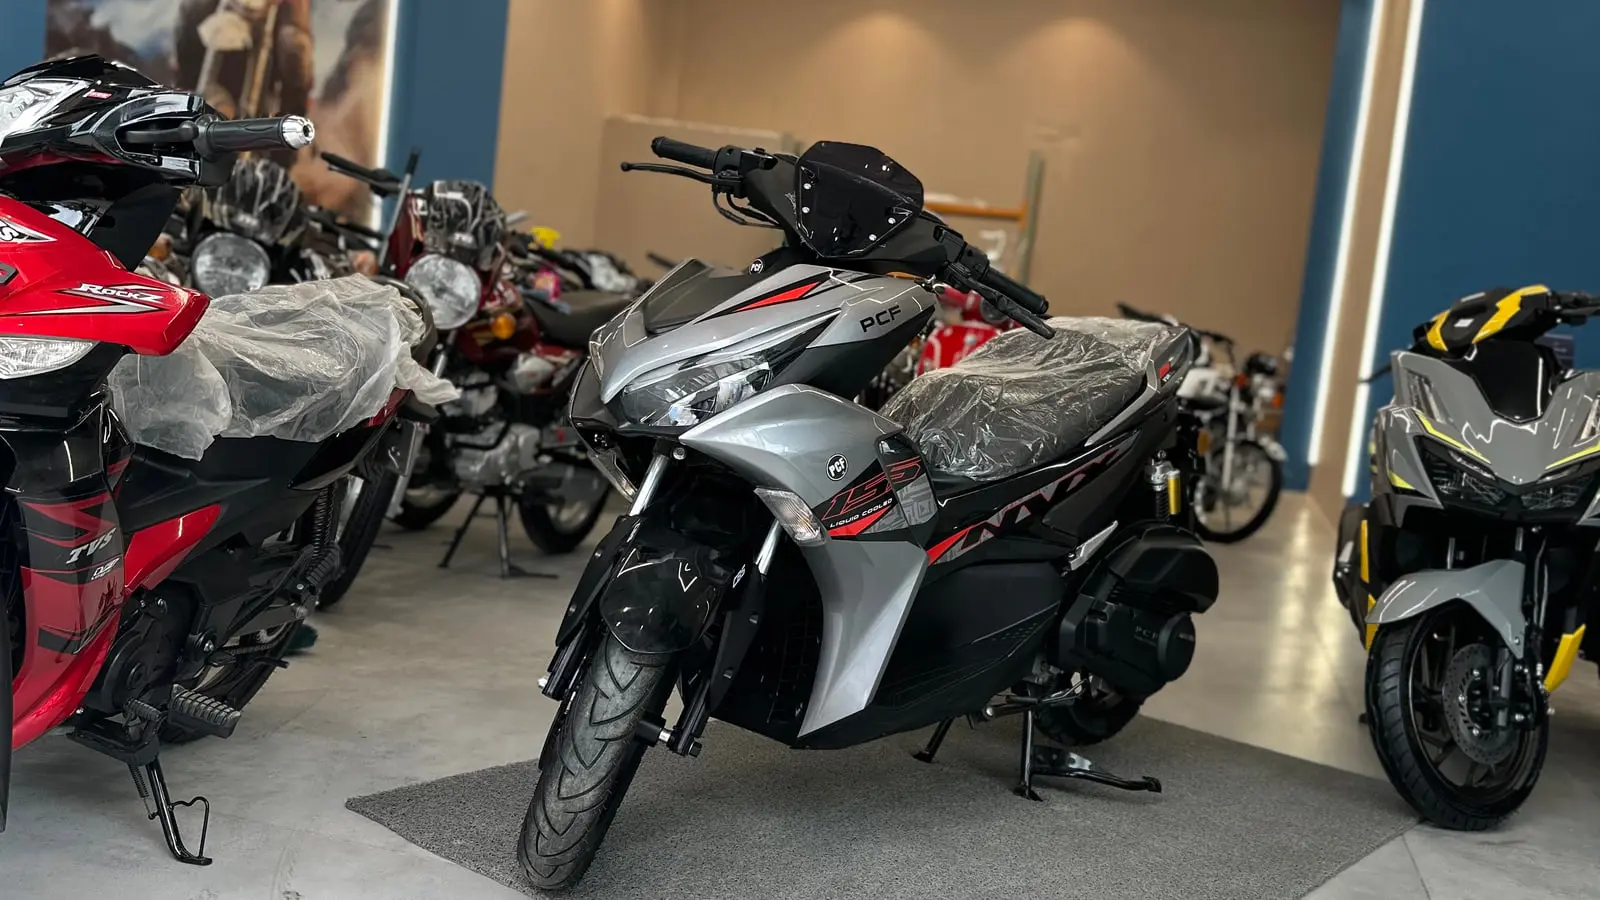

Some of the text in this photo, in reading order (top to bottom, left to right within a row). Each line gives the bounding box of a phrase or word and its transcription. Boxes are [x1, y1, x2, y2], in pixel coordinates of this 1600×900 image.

[860, 305, 901, 332] PCF
[828, 457, 847, 477] PCF
[829, 498, 893, 528] LIQUID COOLED
[66, 527, 117, 565] TVS
